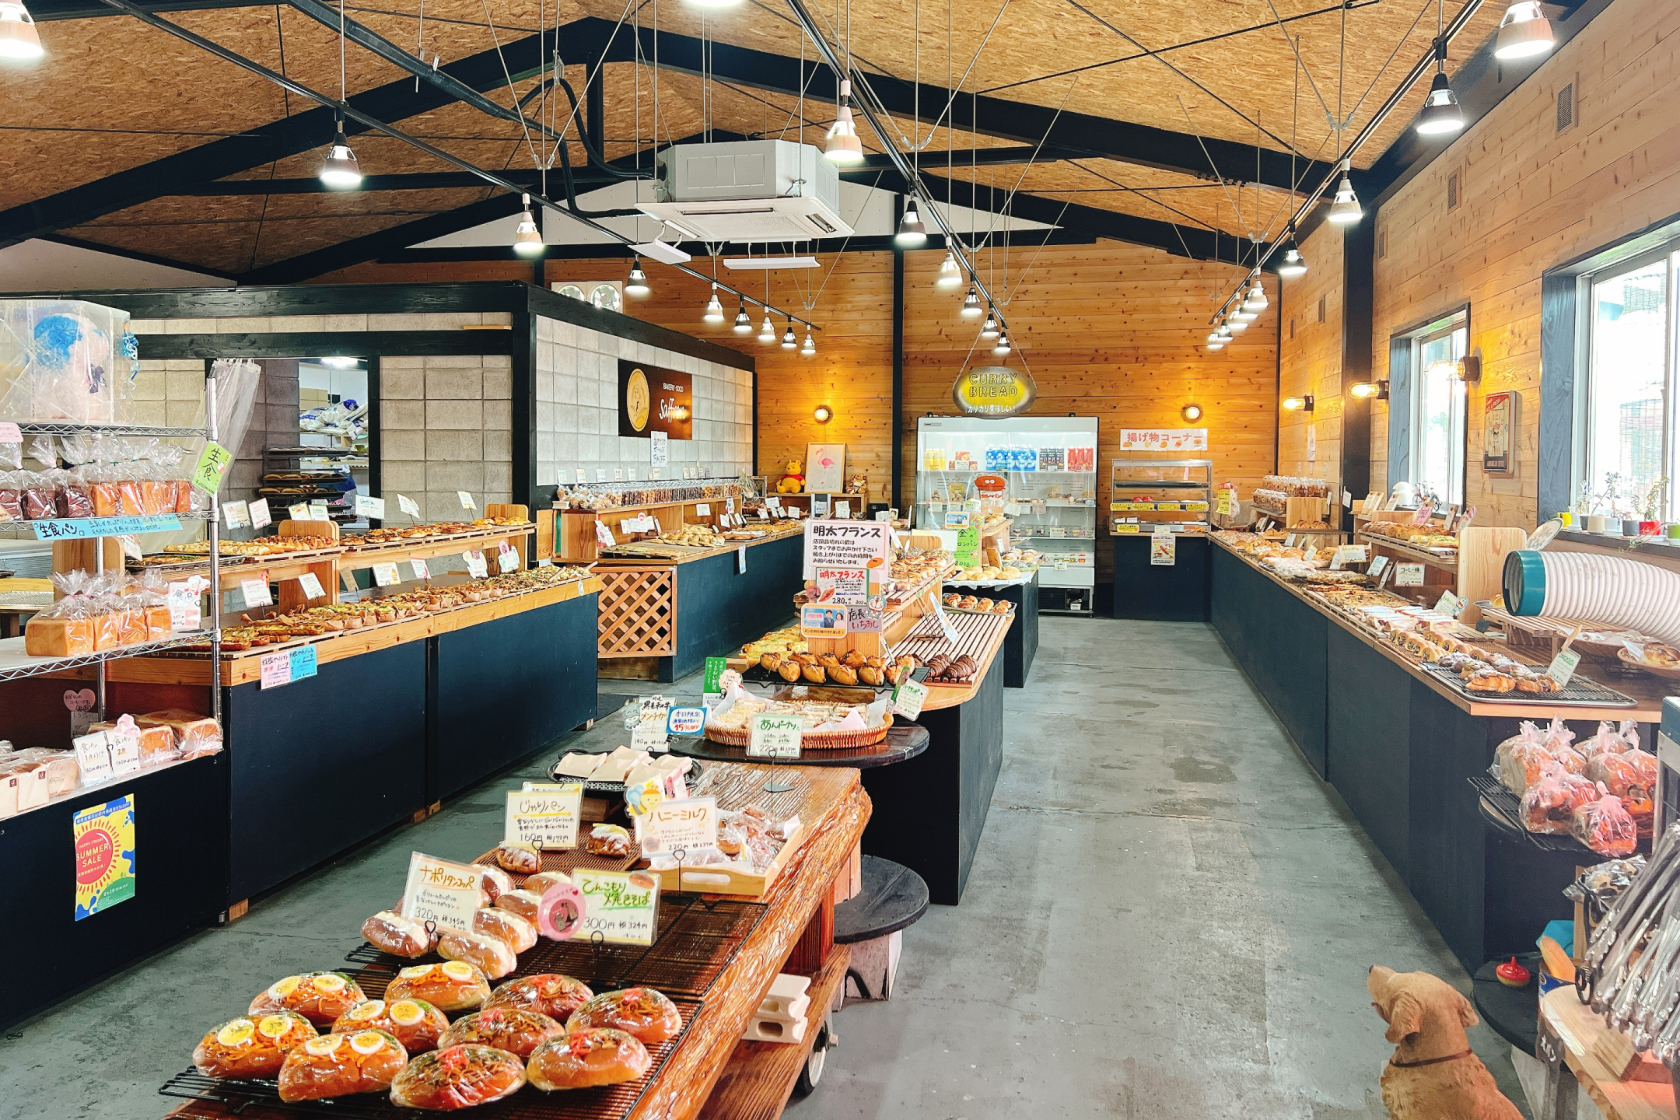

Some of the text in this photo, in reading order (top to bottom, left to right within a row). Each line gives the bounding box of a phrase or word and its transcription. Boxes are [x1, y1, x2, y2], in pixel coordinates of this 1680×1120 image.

[969, 373, 1017, 385] CURRY
[969, 386, 1017, 397] BREAD
[1127, 432, 1203, 442] 揚げ物コーナー
[39, 521, 77, 537] 生食パン
[813, 525, 881, 538] 明太フランス
[819, 570, 865, 579] 明太フランス
[520, 800, 565, 814] じゃりパン
[649, 807, 706, 822] ハニーミルク
[76, 843, 108, 861] SUMMER
[82, 854, 102, 868] SALE
[604, 891, 651, 907] 焼きそば
[415, 907, 438, 922] 320円
[583, 917, 615, 930] 300円
